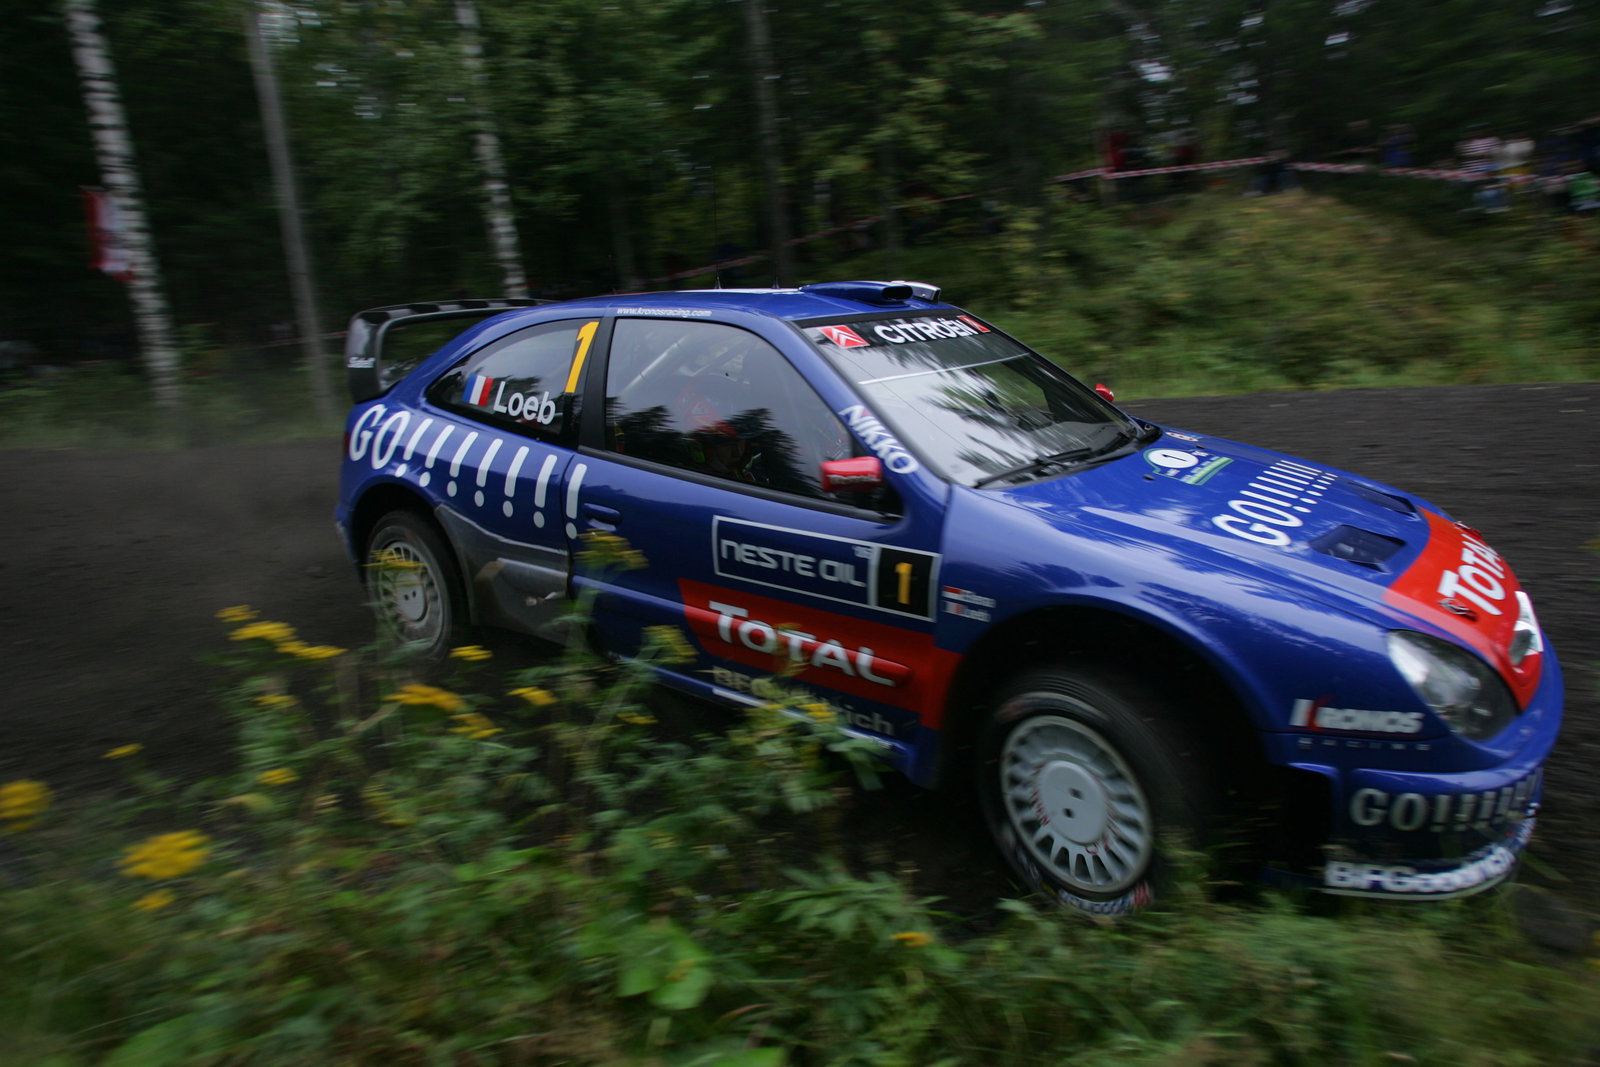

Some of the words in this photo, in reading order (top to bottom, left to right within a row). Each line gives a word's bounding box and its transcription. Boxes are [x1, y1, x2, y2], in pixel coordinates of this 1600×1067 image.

[616, 307, 713, 318] www.kronosracing.com
[874, 318, 979, 344] CITROËN
[565, 321, 599, 393] 1
[493, 381, 556, 425] Loeb
[838, 405, 919, 474] NIKKO
[720, 538, 817, 578] NESTE
[819, 559, 867, 588] OIL
[895, 561, 912, 605] 1
[708, 600, 896, 688] TOTAL
